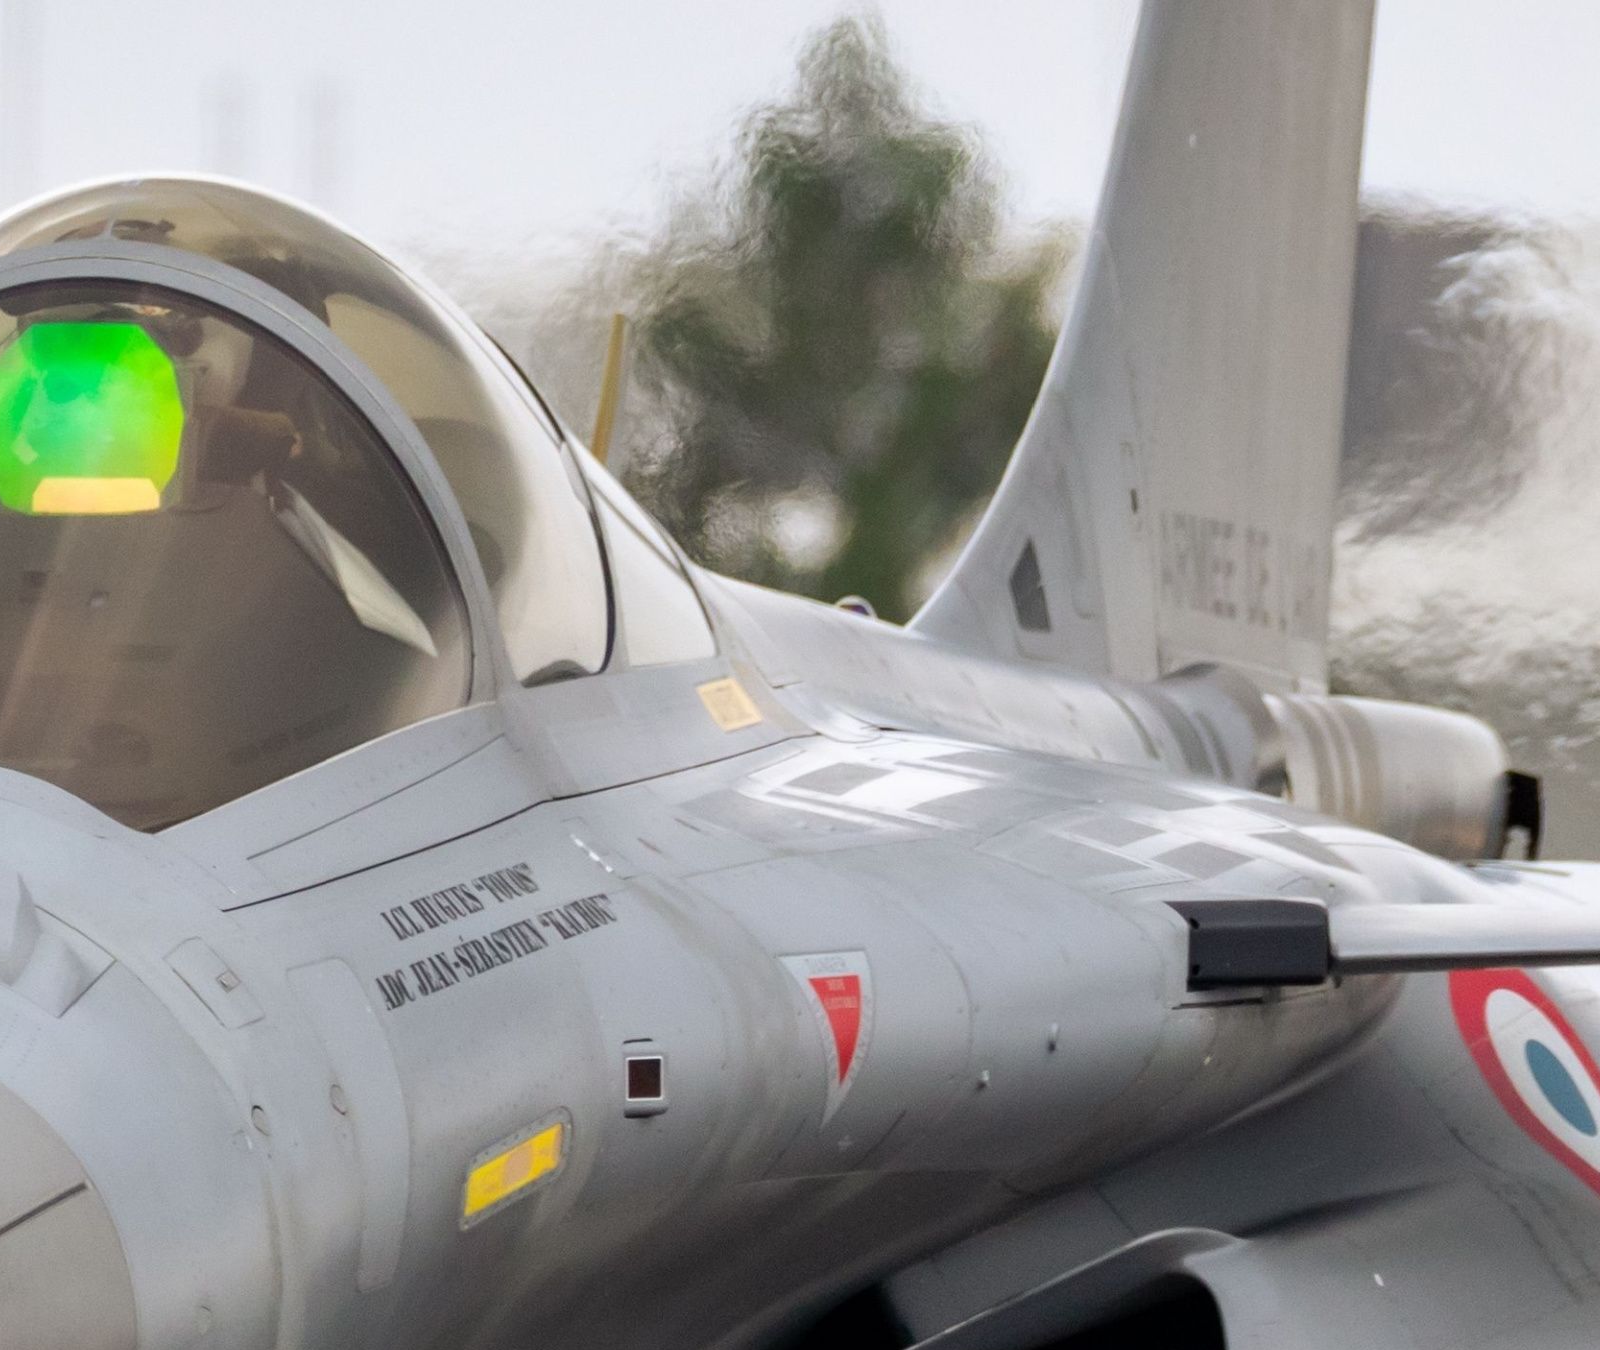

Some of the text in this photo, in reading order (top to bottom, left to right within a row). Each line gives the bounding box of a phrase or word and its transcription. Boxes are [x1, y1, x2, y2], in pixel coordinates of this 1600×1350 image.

[379, 904, 426, 941] LCL
[409, 883, 485, 930] HUGUES
[375, 968, 417, 1011] ADC
[409, 918, 549, 997] JEAN-SÉBASTIEN
